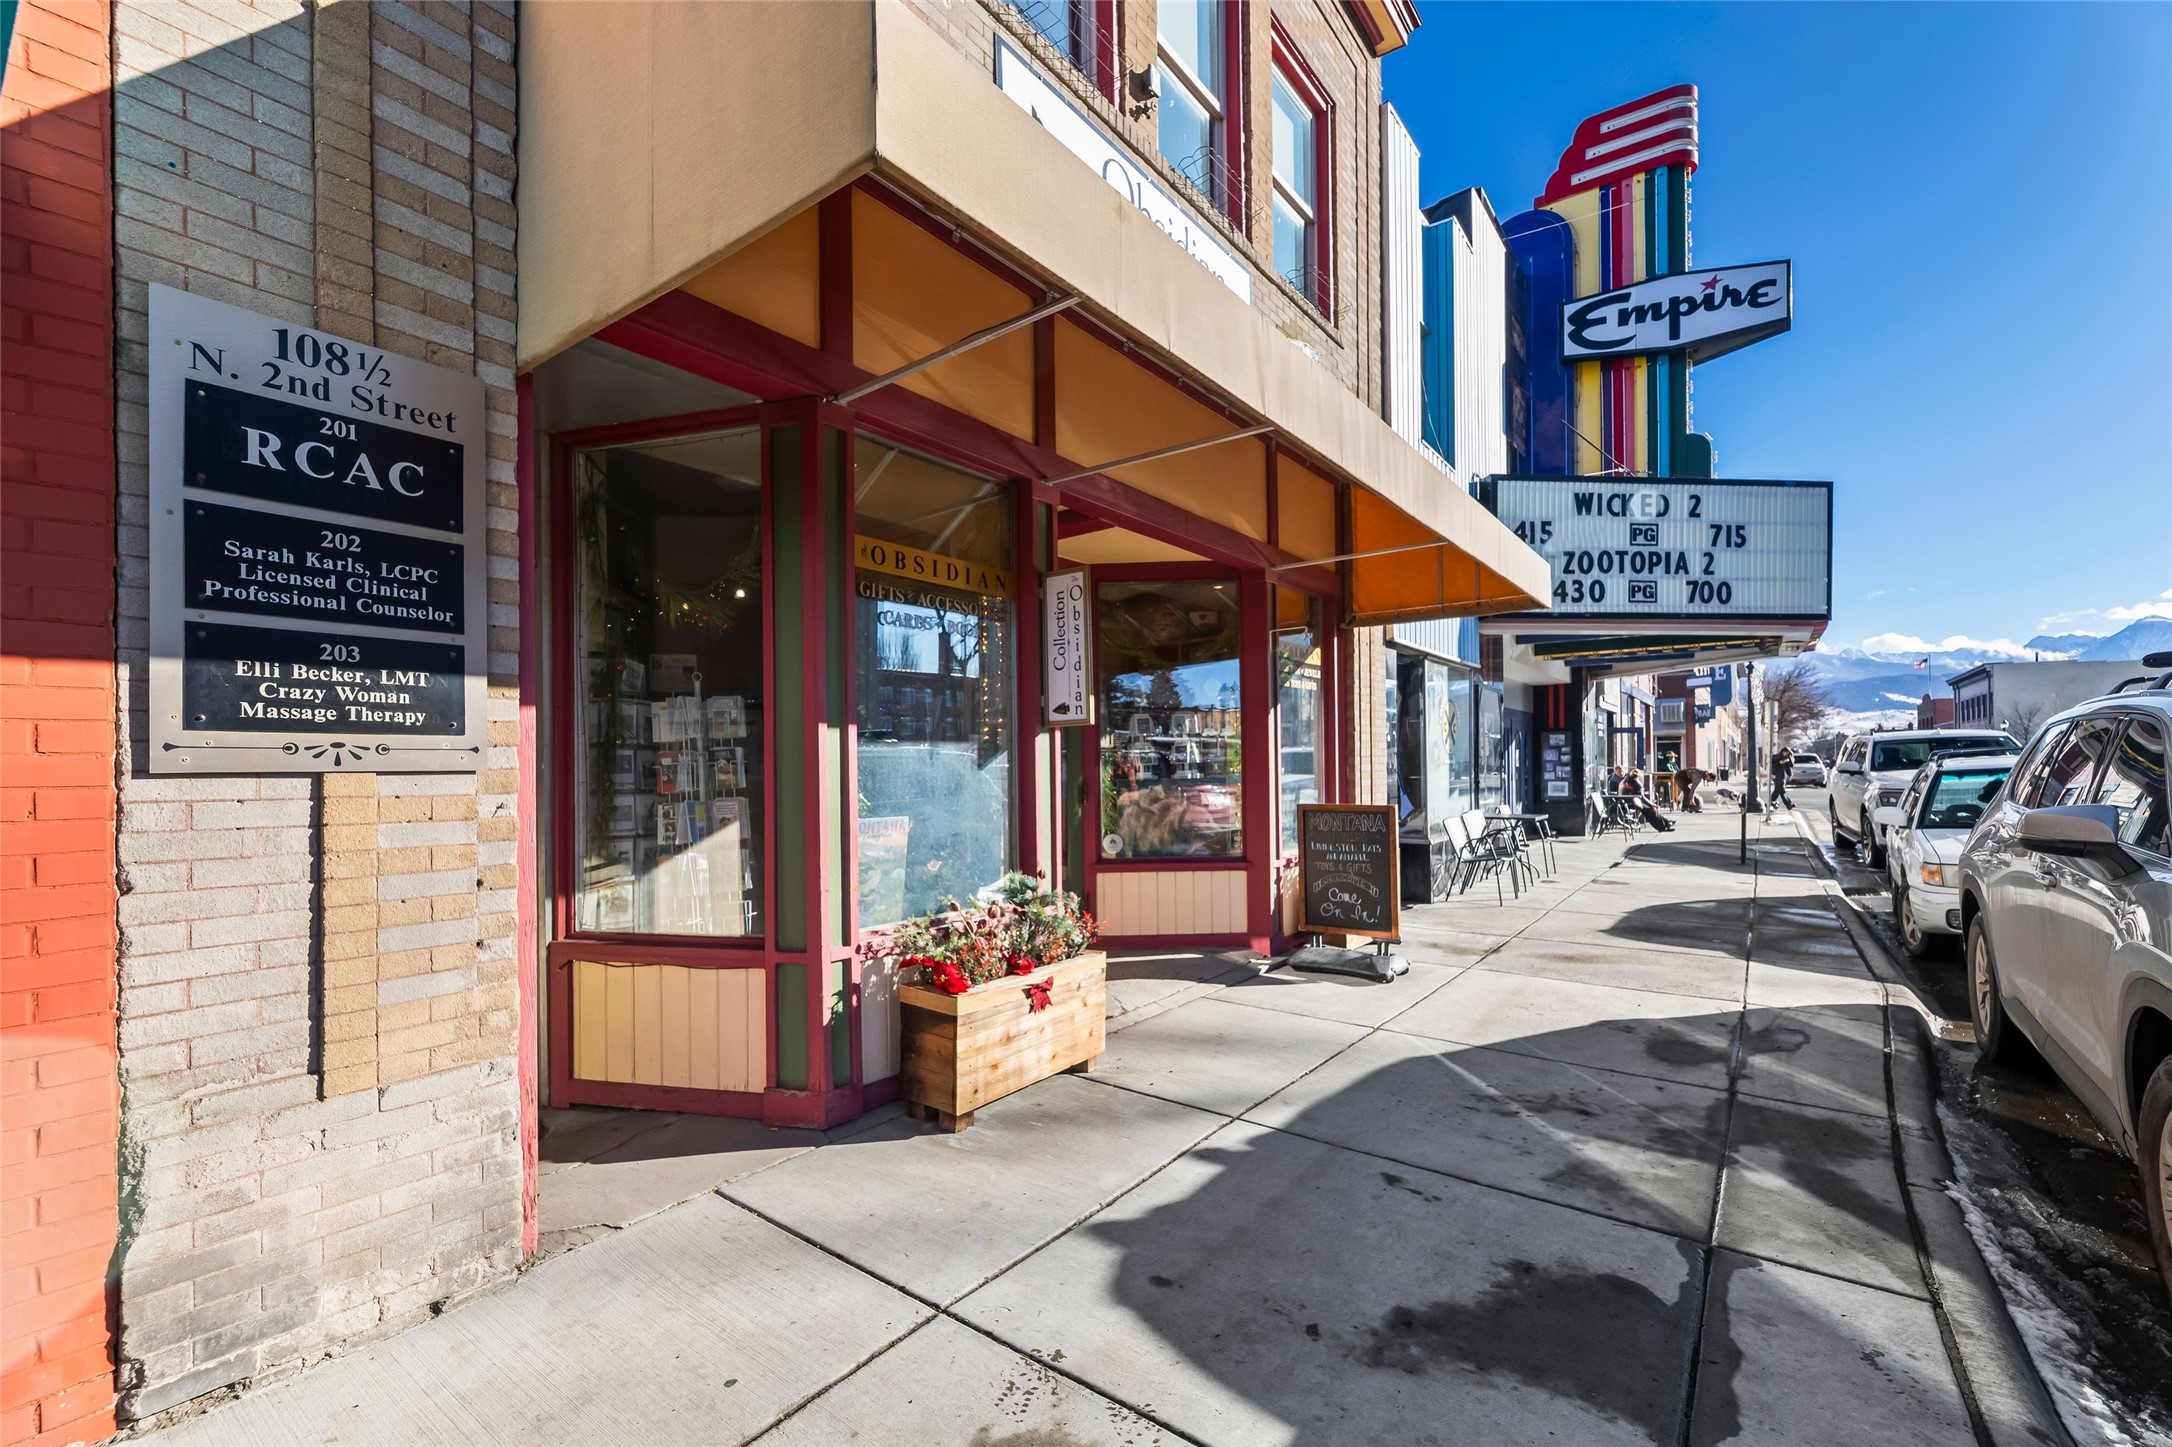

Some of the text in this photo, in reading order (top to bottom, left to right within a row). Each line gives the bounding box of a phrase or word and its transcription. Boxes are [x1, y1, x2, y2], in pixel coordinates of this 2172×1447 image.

[1567, 278, 1783, 350] Empire
[188, 340, 458, 433] N. 2nd Street
[319, 417, 357, 442] 201
[241, 426, 424, 497] RCAC
[1574, 492, 1701, 518] WICKED 2
[320, 530, 362, 553] 202
[1513, 520, 1747, 548] 415 PG 715
[224, 540, 439, 584] Sarah Karls, LCPC
[870, 545, 1006, 592] OBSIDIAN
[1562, 550, 1715, 575] ZOOTOPIA 2
[239, 563, 427, 602] Licensed Clinical
[1552, 580, 1732, 604] 430 PG 700
[204, 579, 454, 624] Professional Counselor
[860, 581, 905, 603] GIFTS
[917, 592, 1008, 622] ACCESSO
[1052, 590, 1066, 671] Collection
[319, 643, 361, 663] 203
[1069, 584, 1084, 716] Obsidian
[235, 660, 430, 688] Elli Becker, LMT
[259, 682, 411, 705] Crazy Woman
[240, 702, 426, 727] Massage Therapy
[859, 821, 905, 834] ONTANA
[1309, 812, 1386, 832] MONTANA
[1314, 861, 1335, 871] TOYS
[1346, 863, 1372, 874] GIFTS
[1329, 887, 1361, 904] Come
[1320, 902, 1344, 918] On
